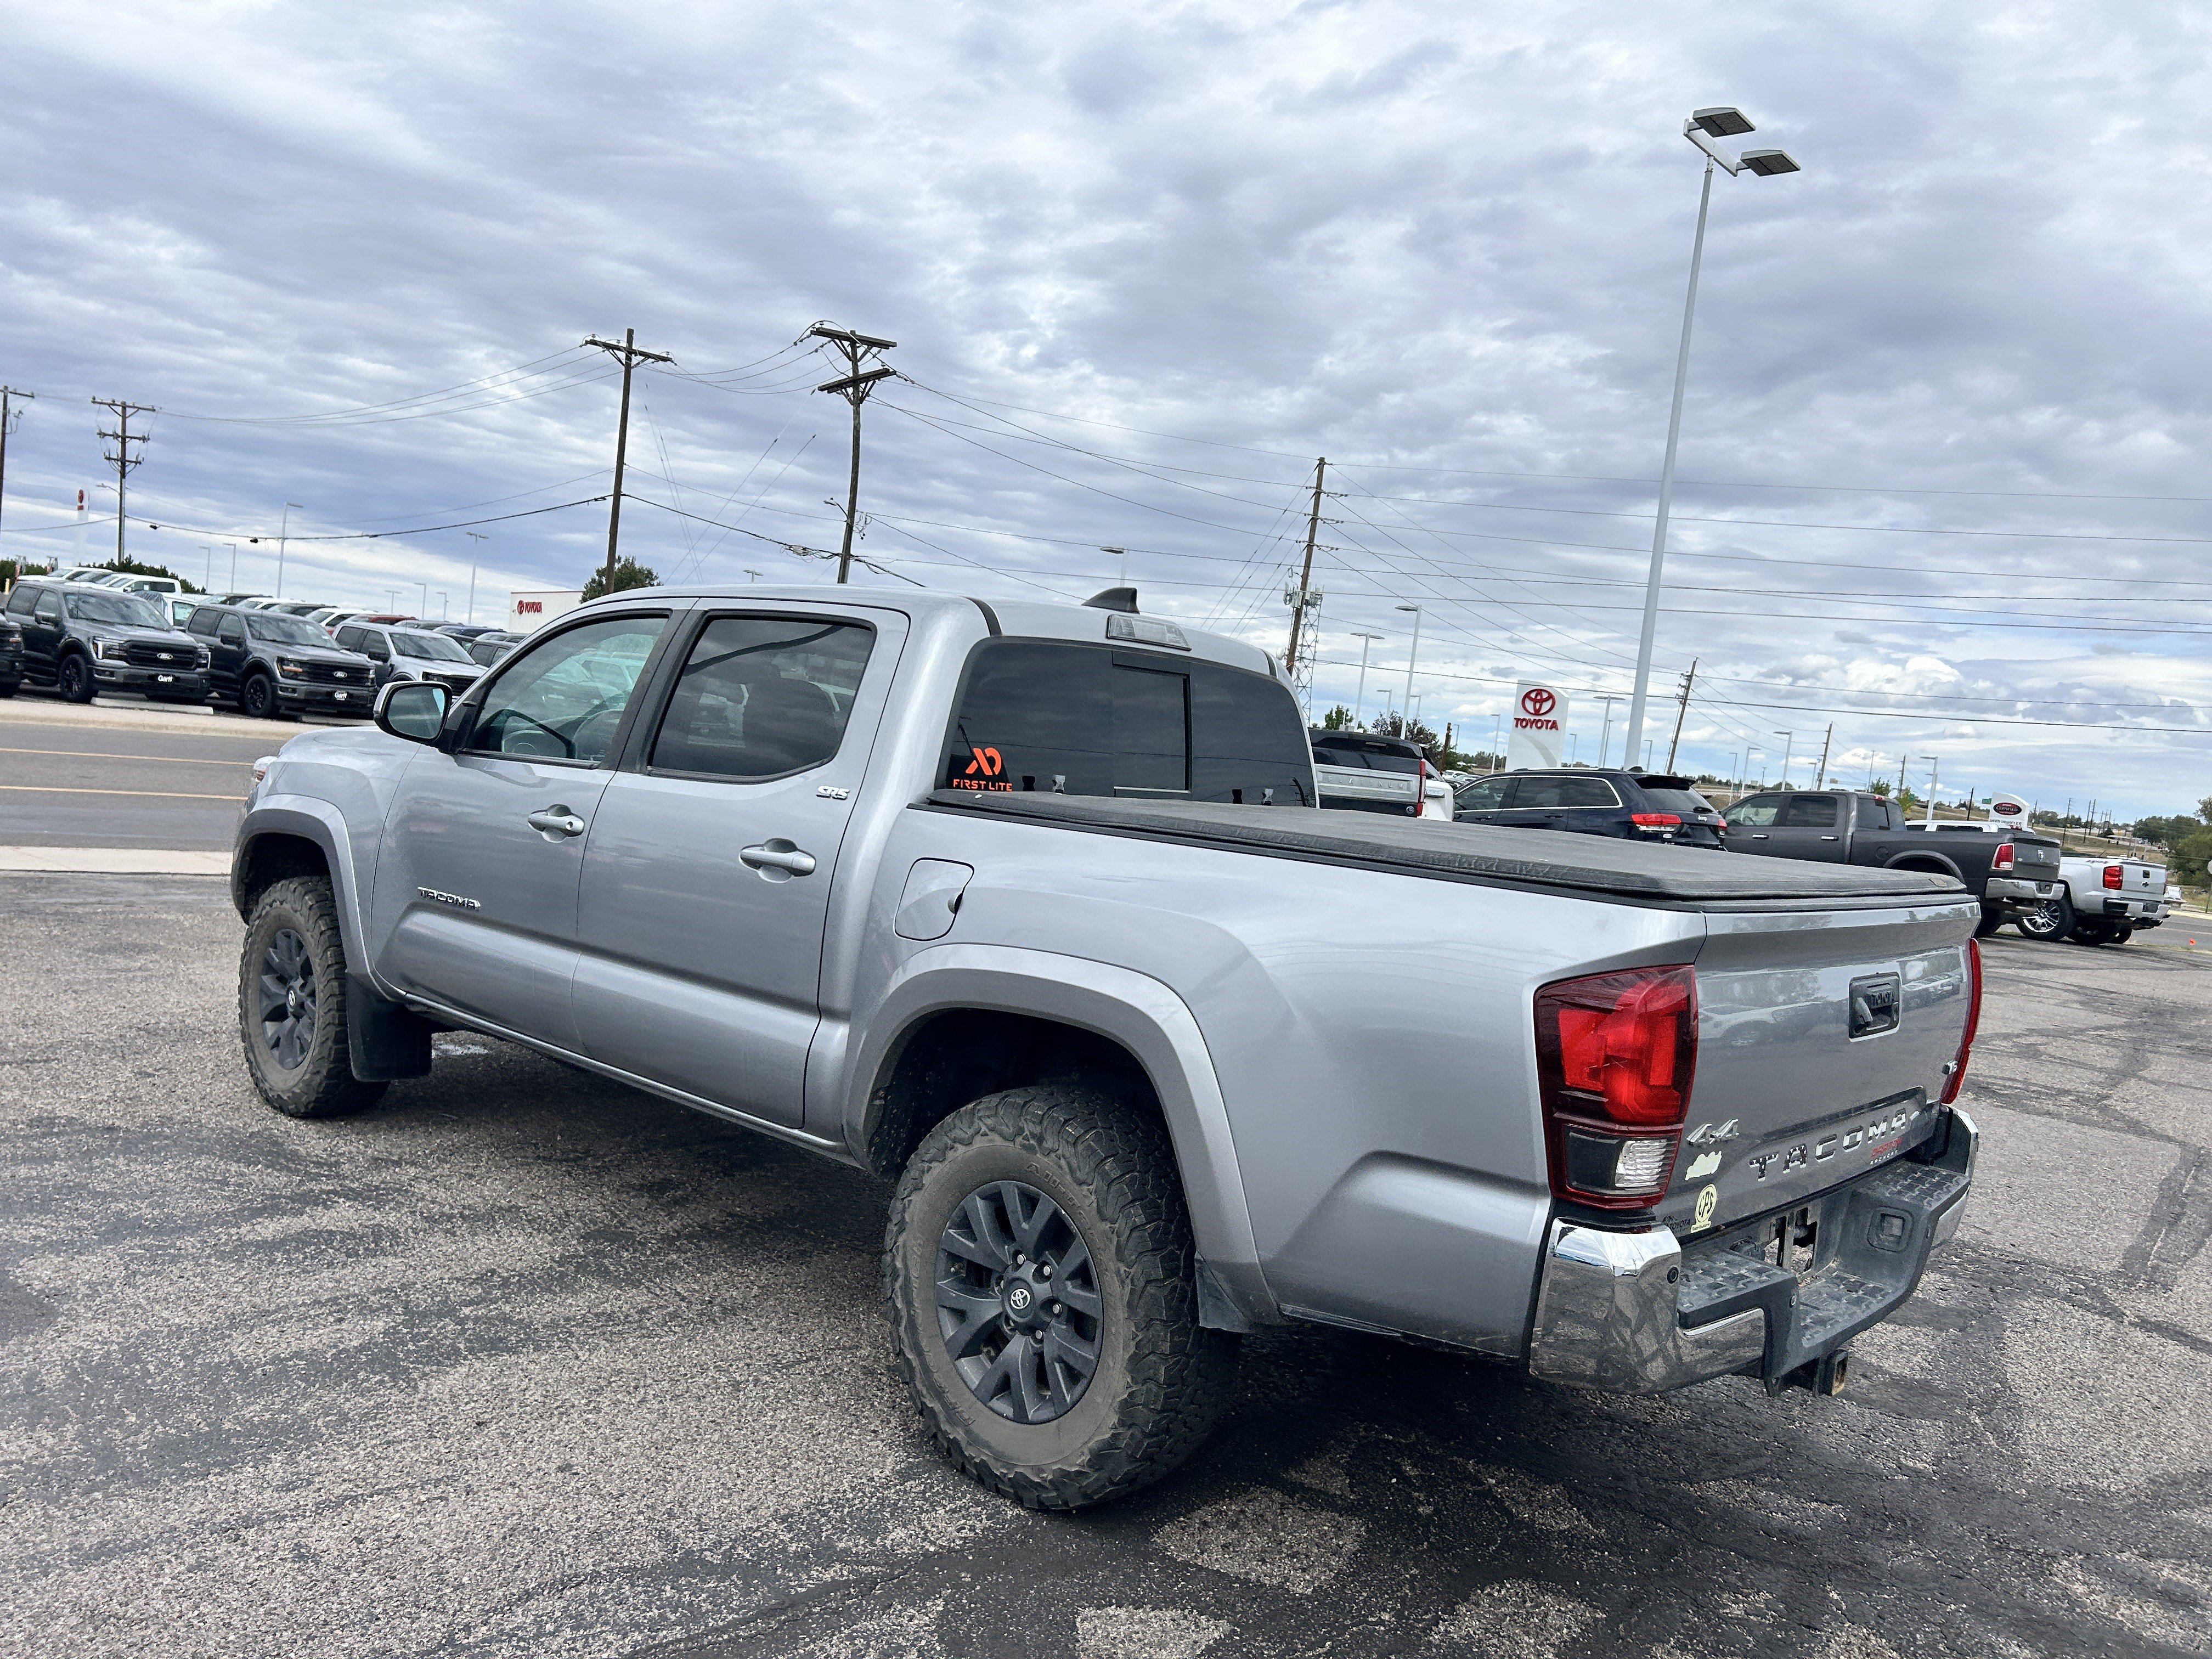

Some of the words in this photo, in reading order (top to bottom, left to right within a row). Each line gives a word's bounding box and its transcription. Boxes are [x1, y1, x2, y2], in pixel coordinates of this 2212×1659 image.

[1514, 717, 1559, 731] TOYOTA
[953, 778, 986, 789] FIRST
[989, 782, 1013, 792] LITE
[417, 886, 481, 911] TACOMA
[1749, 1108, 1907, 1182] TACOMA
[1698, 1190, 1714, 1218] CPS
